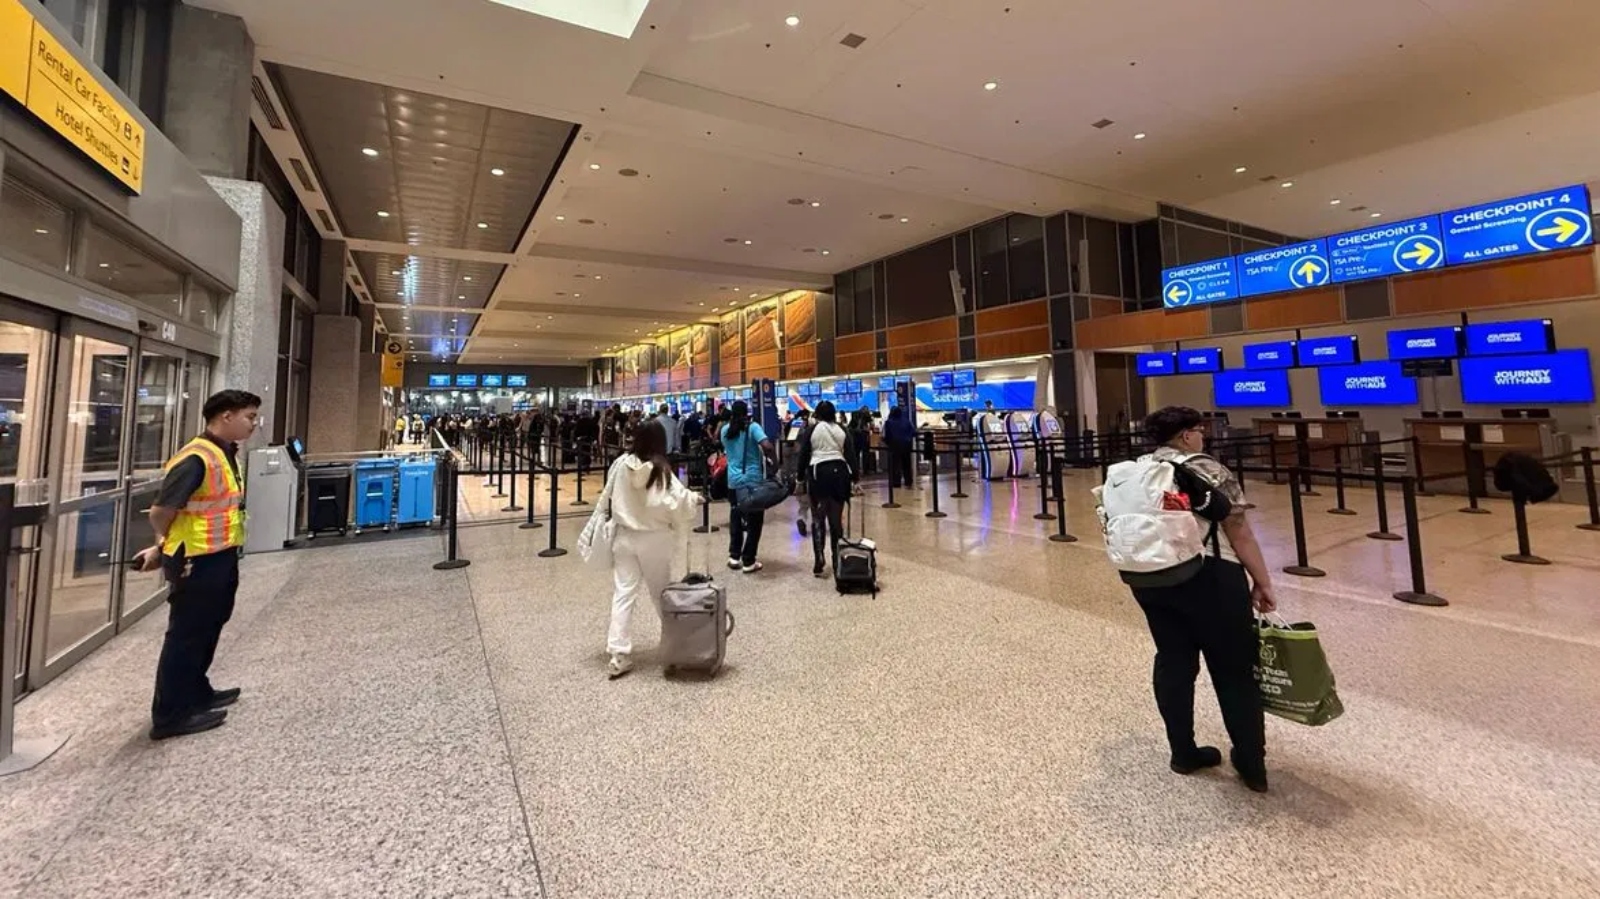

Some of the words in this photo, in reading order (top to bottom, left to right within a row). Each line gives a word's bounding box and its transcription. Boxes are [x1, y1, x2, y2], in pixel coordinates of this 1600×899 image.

[38, 40, 73, 86] Rental
[75, 77, 91, 101] Car
[92, 94, 121, 133] Facility
[55, 102, 83, 136] Hotel
[85, 126, 119, 165] Shuttles
[1453, 196, 1555, 225] CHECKPOINT
[1559, 194, 1571, 204] 4
[1336, 224, 1416, 247] CHECKPOINT
[1418, 222, 1428, 232] 3
[1450, 224, 1482, 235] General
[1483, 216, 1527, 230] Screening
[1244, 246, 1308, 265] CHECKPOINT
[1310, 244, 1318, 252] 2
[1464, 250, 1482, 259] ALL
[1484, 244, 1519, 255] GATES
[1169, 262, 1222, 279] CHECKPOINT
[1246, 267, 1260, 276] TSA
[1260, 265, 1274, 273] Pre
[1495, 376, 1552, 385] WITHAUS
[1496, 369, 1551, 378] JOURNEY
